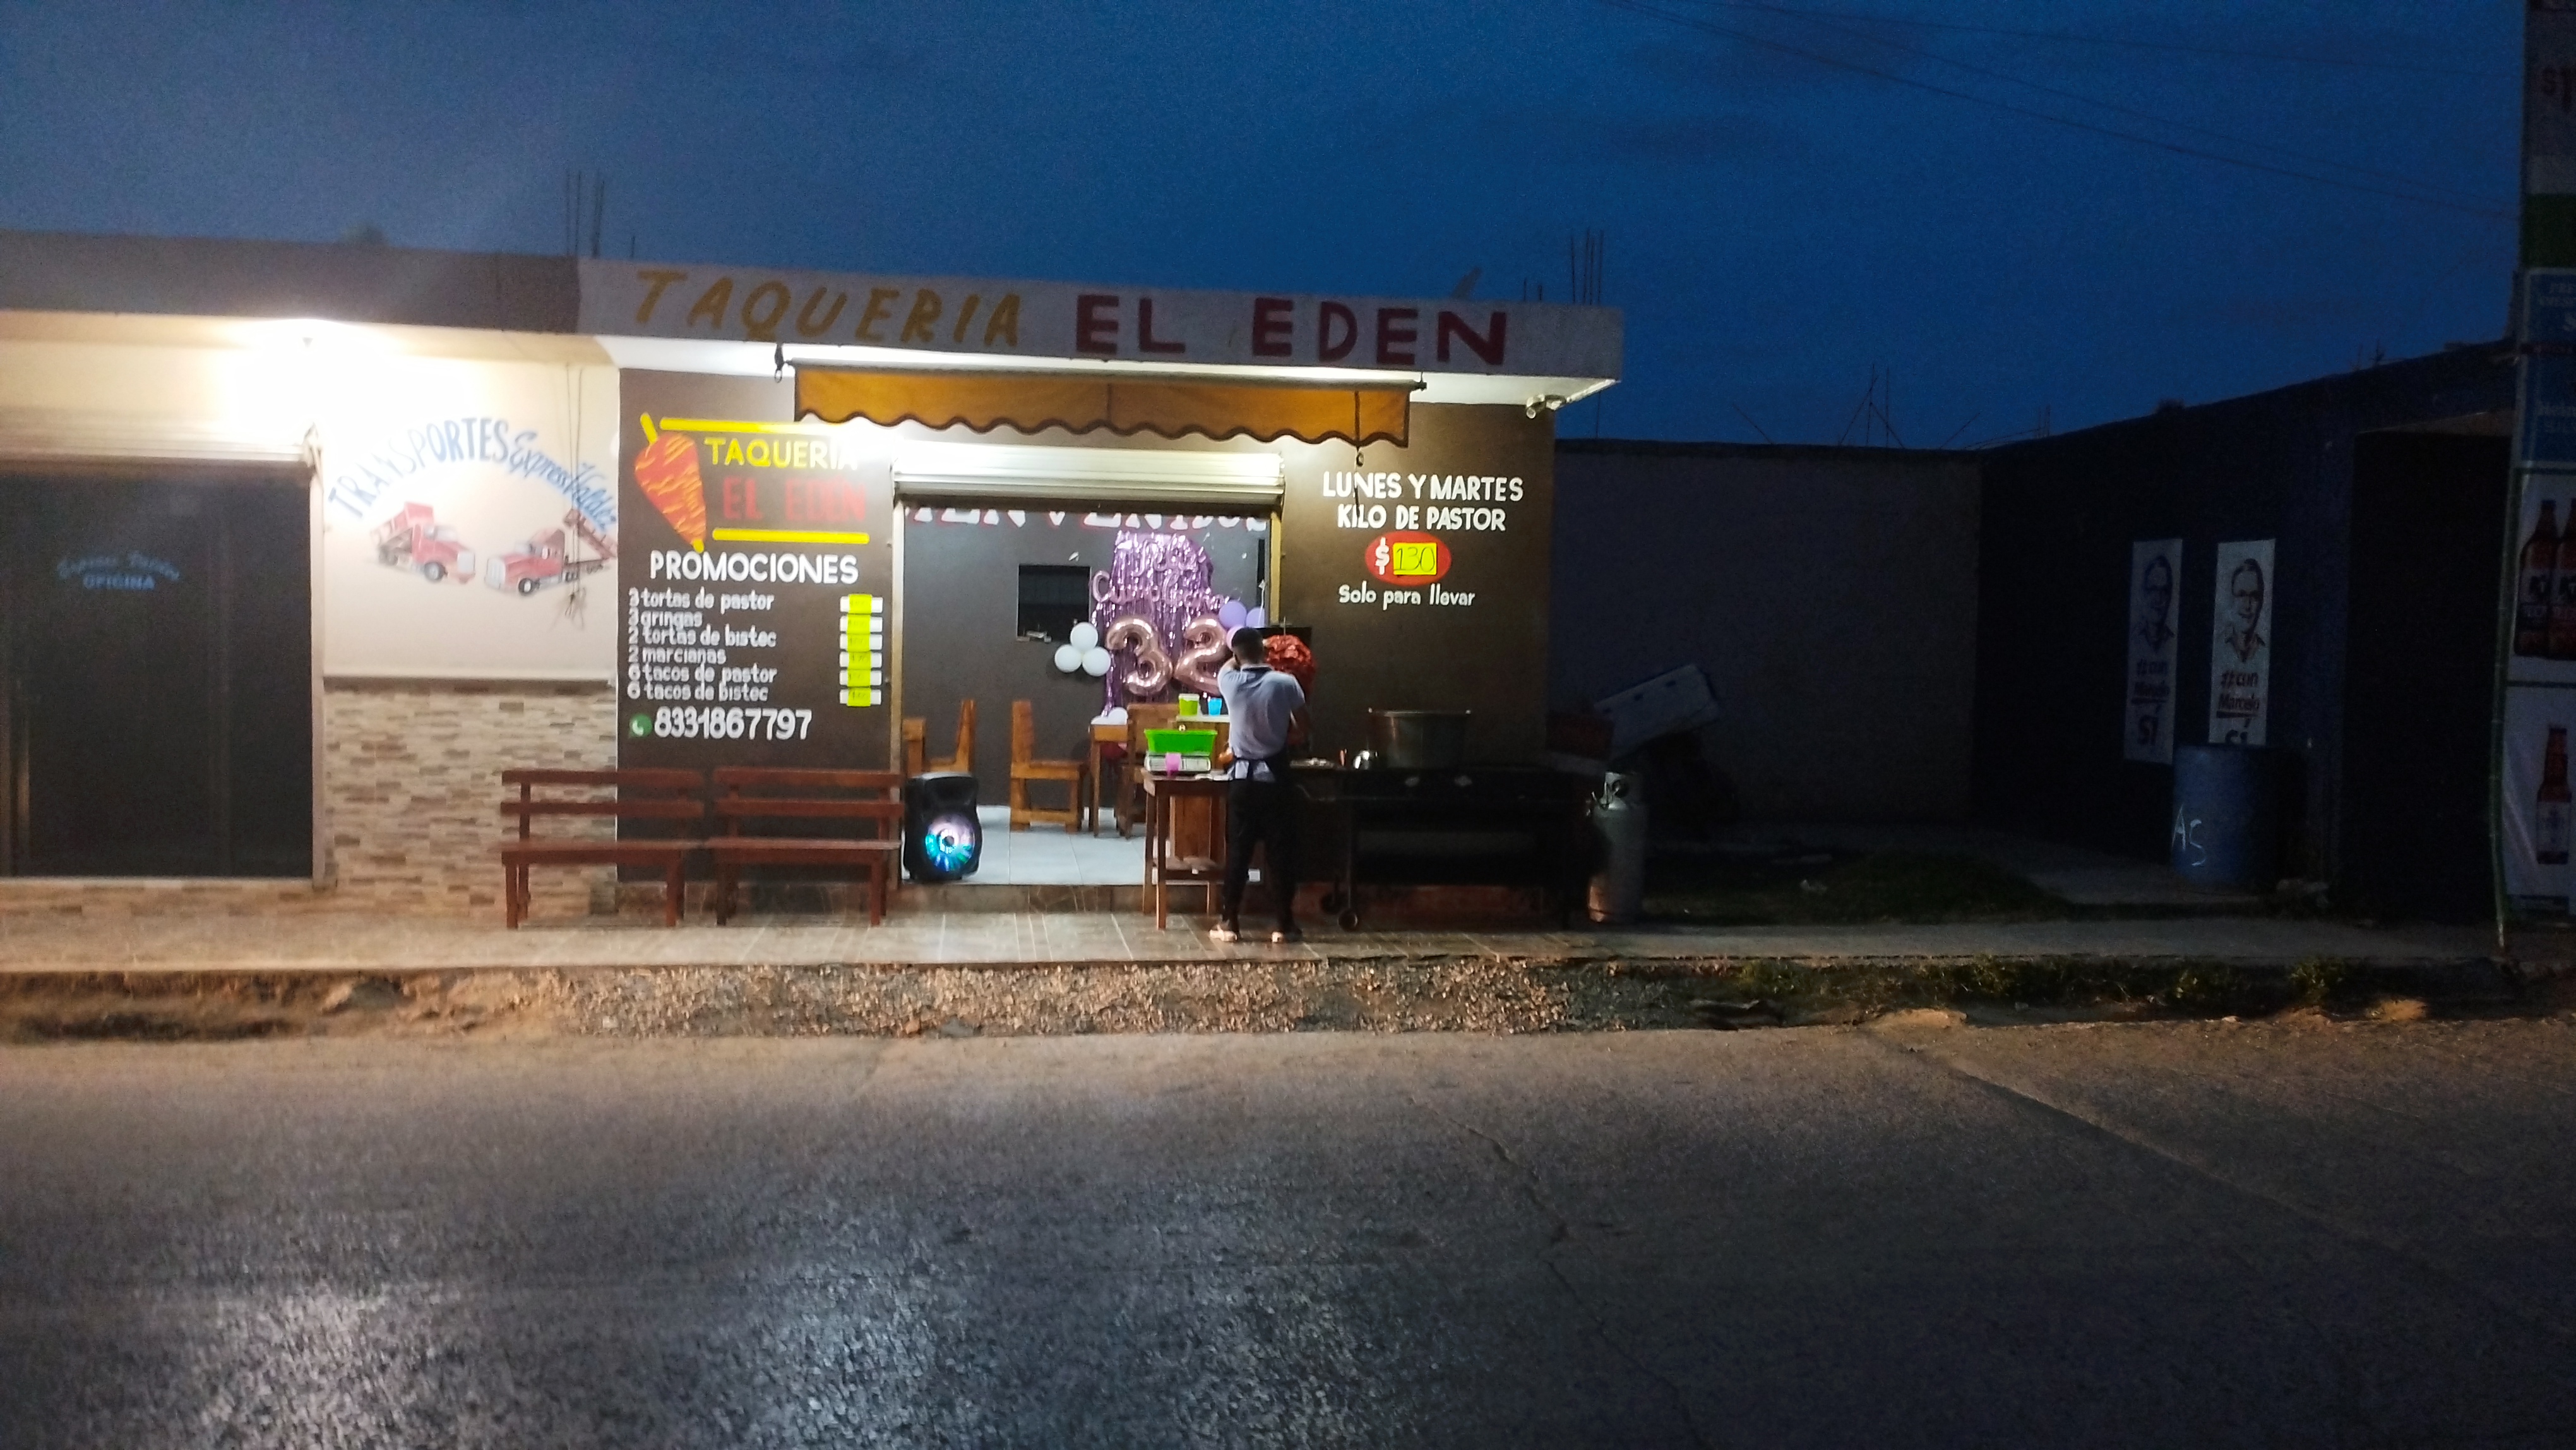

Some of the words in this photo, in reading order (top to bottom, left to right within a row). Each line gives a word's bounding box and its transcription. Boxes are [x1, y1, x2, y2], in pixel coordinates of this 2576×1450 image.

[635, 270, 1021, 347] TAQUERIA
[1076, 294, 1186, 355] EL
[1251, 297, 1506, 366] EDEN
[703, 437, 858, 471] TAQUERIA
[724, 476, 763, 520] EL
[1323, 471, 1402, 499] LUNES
[1407, 474, 1427, 500] Y
[1430, 474, 1524, 501] MARTES
[1337, 504, 1387, 529] KILO
[1395, 505, 1419, 530] DE
[1426, 506, 1506, 531] PASTOR
[650, 549, 859, 584] PROMOCIONES
[641, 587, 691, 609] tortas
[720, 589, 775, 615] pastor
[1339, 580, 1376, 603] Solo
[1383, 590, 1421, 611] para
[1429, 583, 1476, 606] llevar
[640, 611, 703, 632] gringas
[642, 624, 696, 645] tortas
[700, 624, 720, 645] de
[725, 623, 777, 647] bistec
[642, 647, 727, 665] marcianas
[643, 663, 690, 683] tacos
[722, 663, 778, 687] pastor
[644, 681, 692, 700] tacos
[719, 682, 769, 702] bistec
[654, 706, 812, 740] 8331867797
